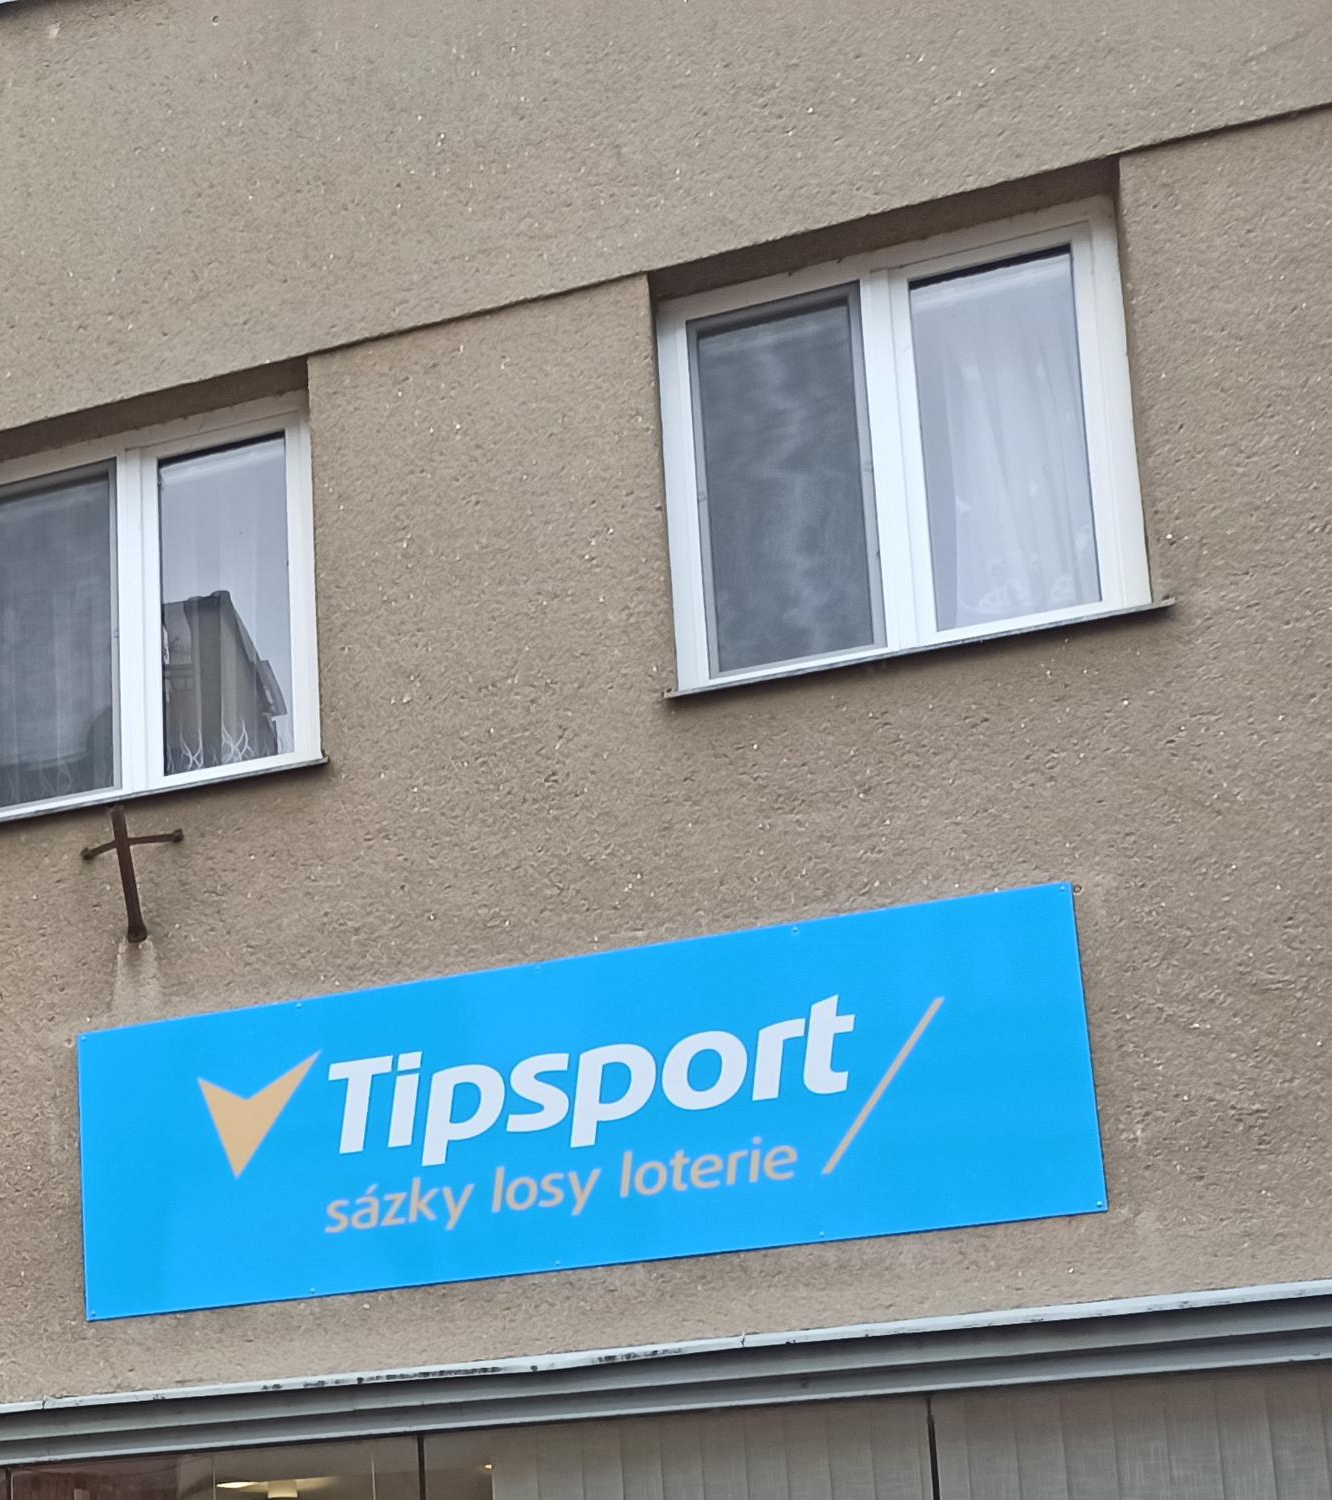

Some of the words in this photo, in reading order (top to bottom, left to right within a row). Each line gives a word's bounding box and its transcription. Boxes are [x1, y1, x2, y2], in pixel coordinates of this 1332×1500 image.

[327, 993, 856, 1167] Tipsport
[324, 1177, 476, 1234] sázky
[491, 1166, 603, 1216] losy
[618, 1136, 800, 1199] loterie
